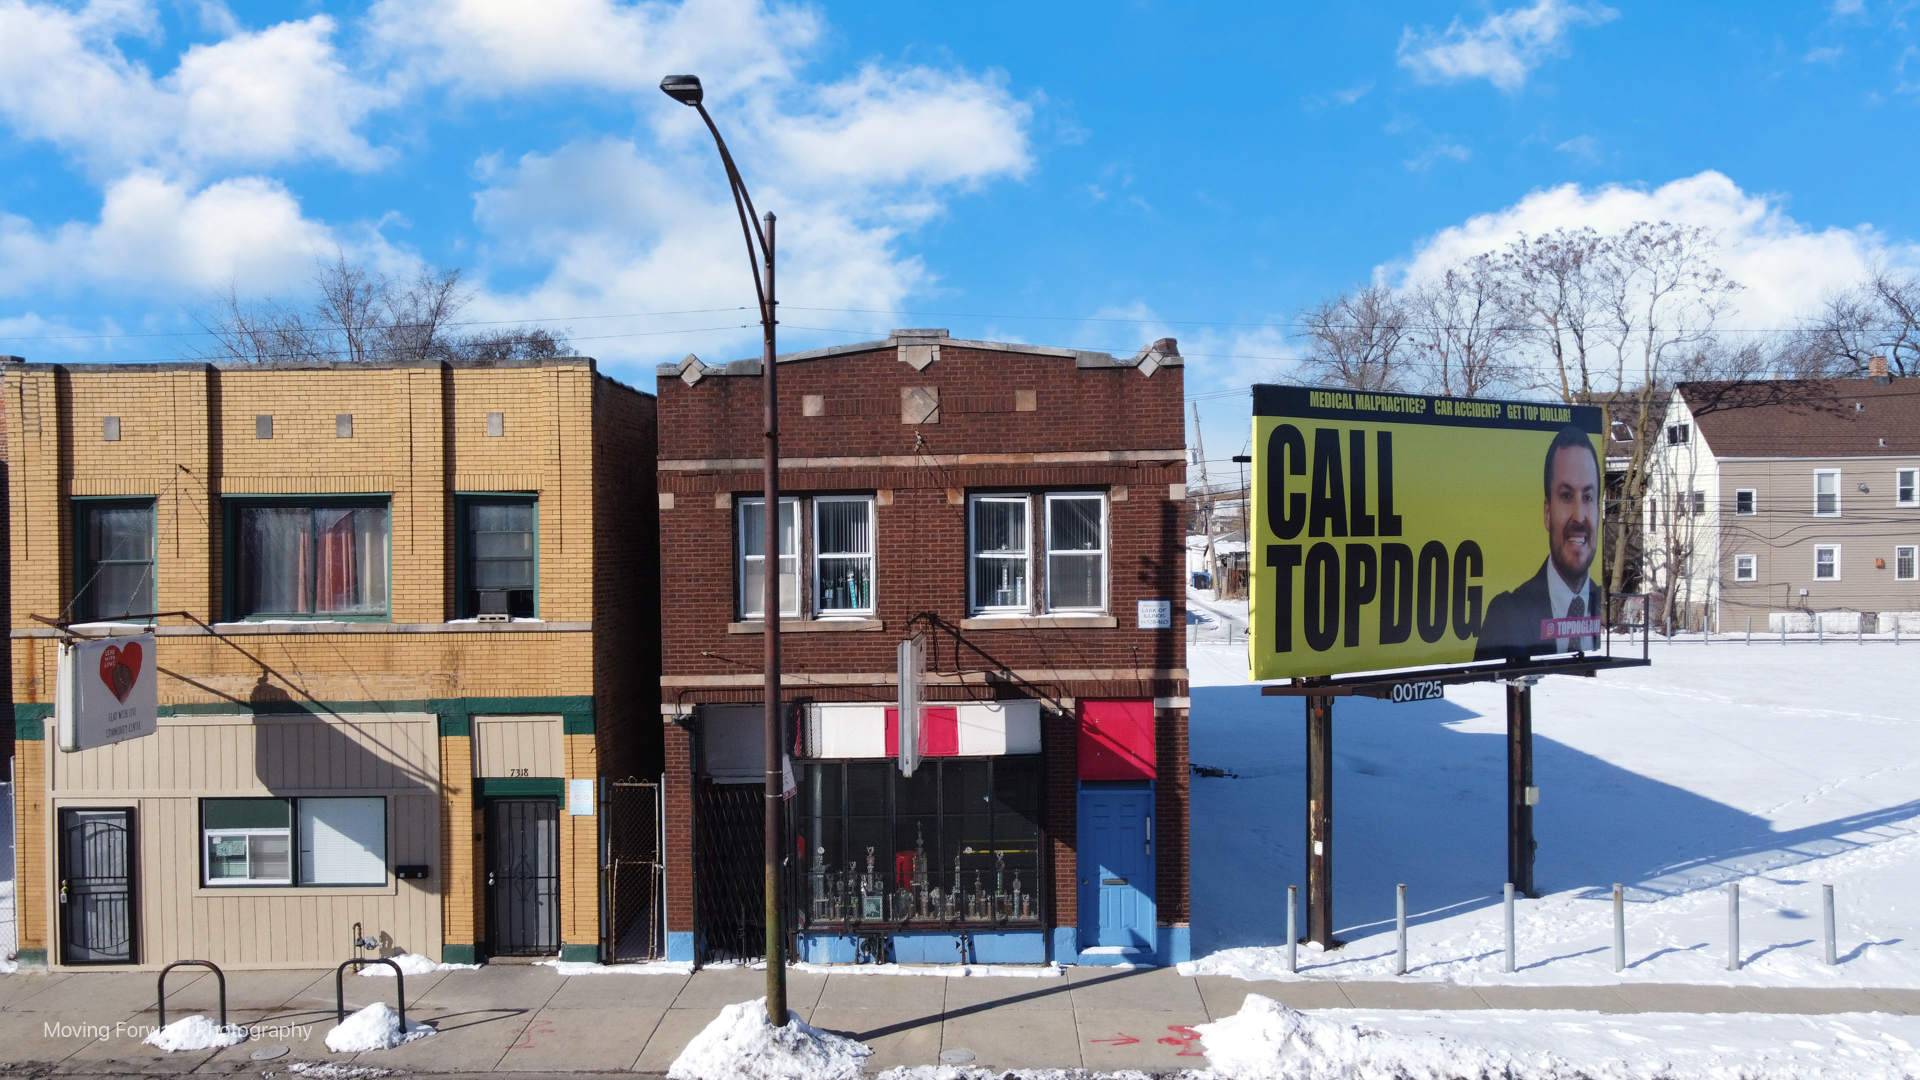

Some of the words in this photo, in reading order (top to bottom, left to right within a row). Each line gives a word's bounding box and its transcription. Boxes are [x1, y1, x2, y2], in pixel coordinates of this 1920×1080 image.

[1309, 390, 1354, 410] MEDICAL
[1355, 393, 1426, 414] MALPRACTICE?
[1434, 399, 1453, 417] CAR
[1454, 401, 1501, 419] ACCIDENT?
[1507, 405, 1522, 420] GET
[1523, 407, 1539, 421] TOP
[1540, 408, 1571, 423] DOLLAR!
[1267, 423, 1402, 540] CALL
[1266, 539, 1484, 653] TOPDOG
[1557, 619, 1600, 636] TOPDOGLAW
[1393, 680, 1443, 702] 001725
[510, 768, 529, 777] 7318
